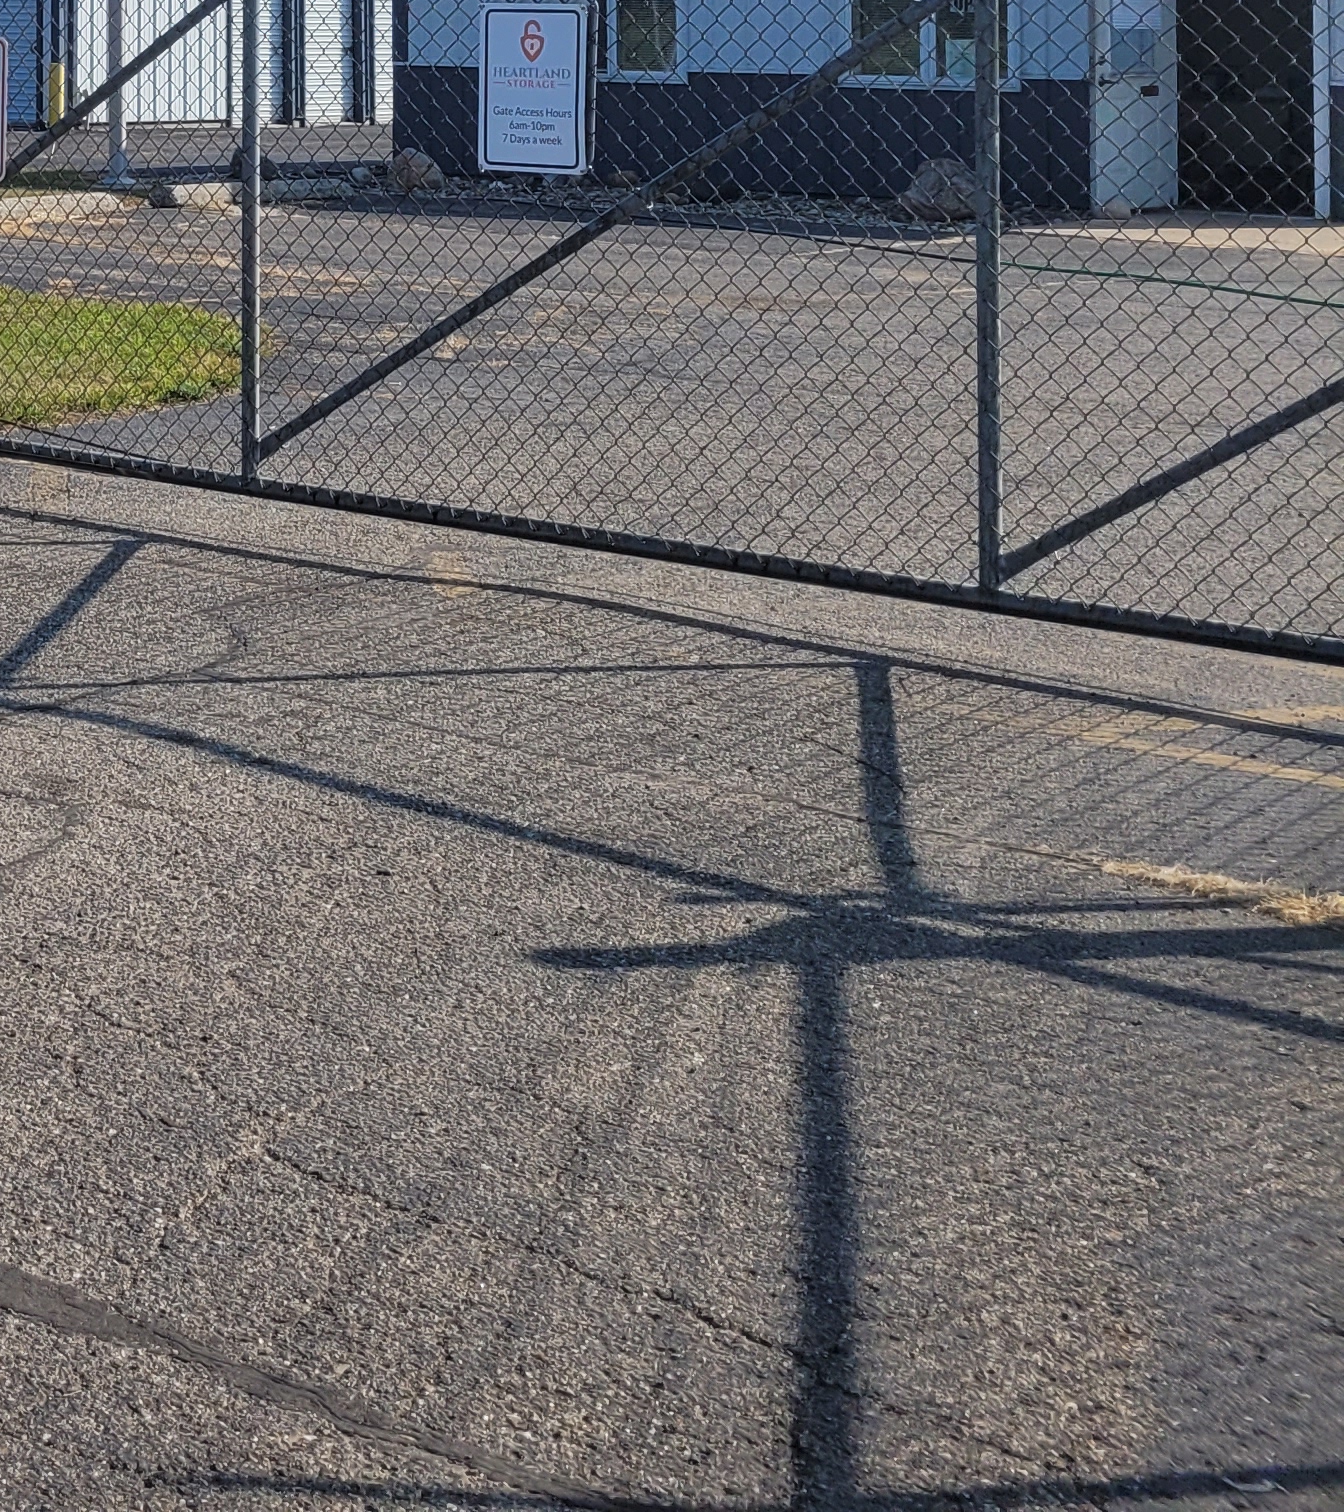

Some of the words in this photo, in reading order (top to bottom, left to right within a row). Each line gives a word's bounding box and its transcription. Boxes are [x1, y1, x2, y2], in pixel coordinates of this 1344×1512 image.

[493, 66, 571, 80] HEARTLAND
[506, 79, 556, 89] STORAGE
[493, 106, 514, 116] Gate
[515, 107, 544, 118] Access
[546, 108, 572, 119] Hours
[509, 120, 555, 133] 6am-10pm
[502, 133, 508, 142] 7
[510, 134, 531, 146] Days
[539, 135, 563, 146] week
